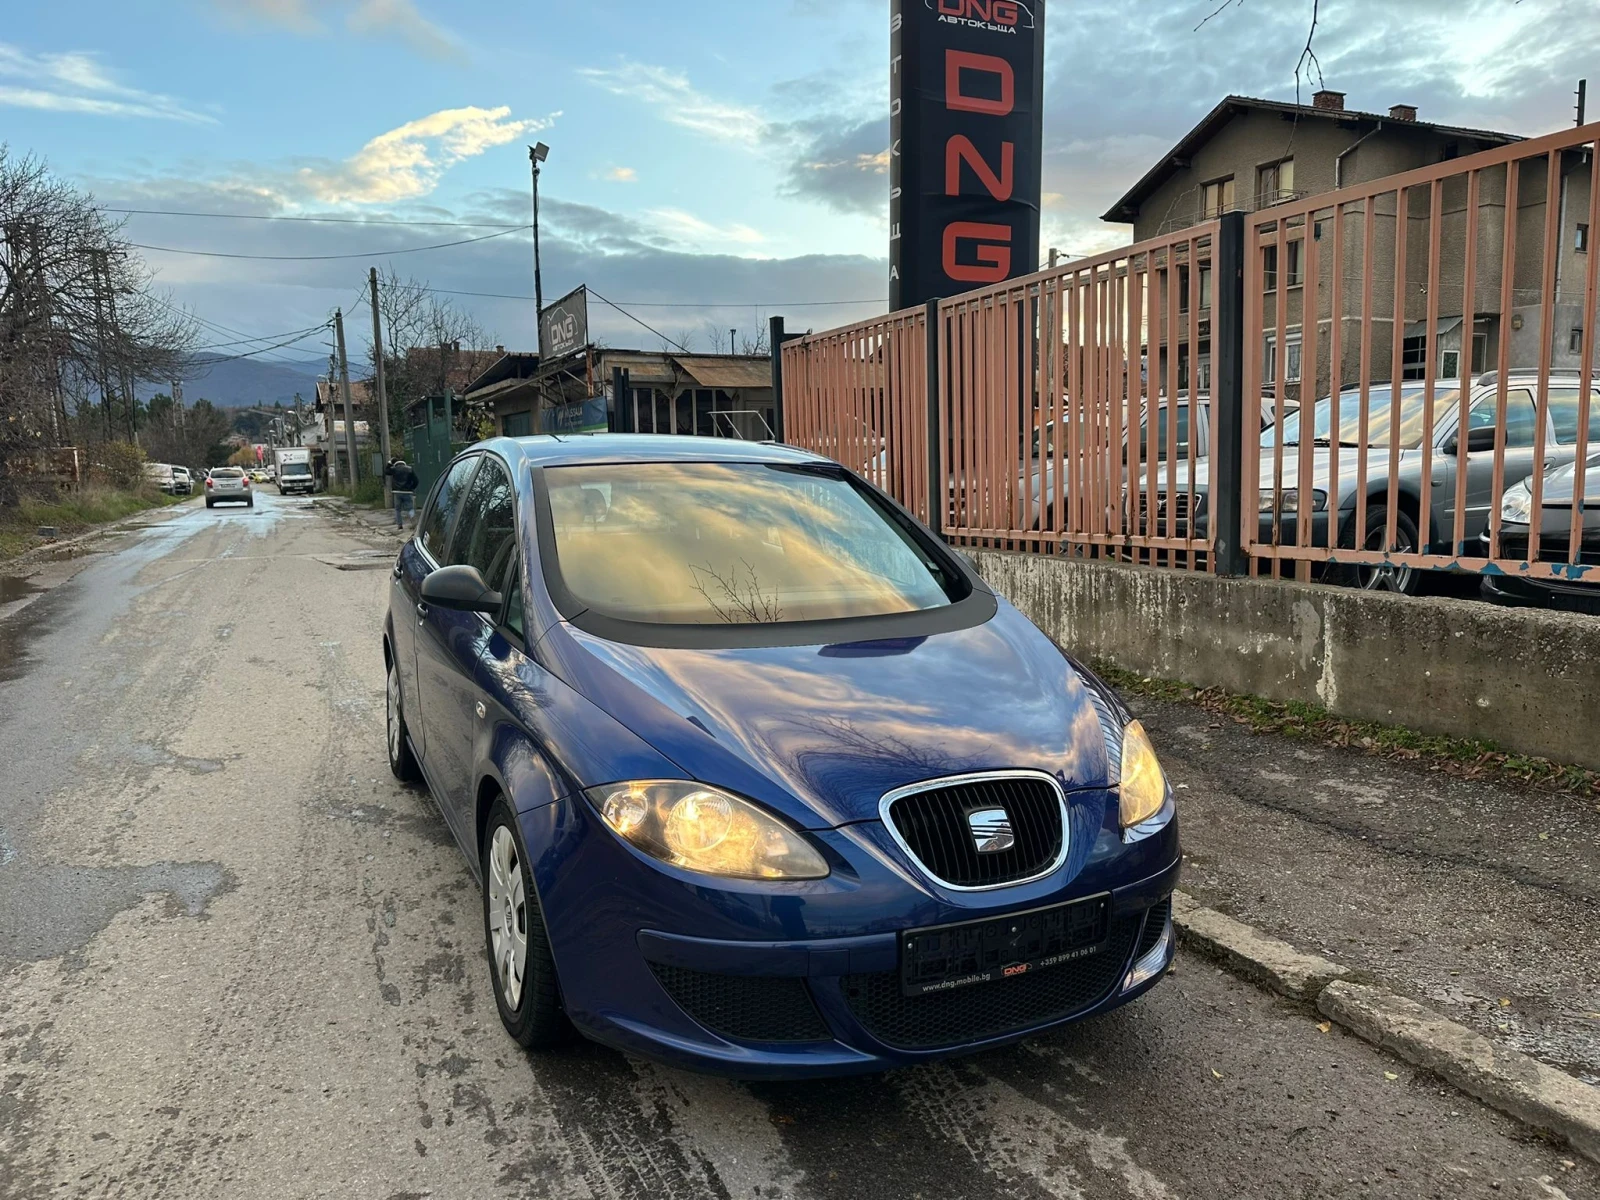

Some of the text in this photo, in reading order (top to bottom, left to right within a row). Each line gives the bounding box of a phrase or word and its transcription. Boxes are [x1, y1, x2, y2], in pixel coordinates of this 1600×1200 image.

[943, 48, 1015, 283] DNG
[551, 316, 574, 346] DNG
[1040, 956, 1057, 967] +359
[1058, 953, 1071, 962] 899
[1089, 946, 1097, 954] 01
[1004, 963, 1027, 975] DNG
[922, 973, 991, 992] www.dng.mobile.bg
